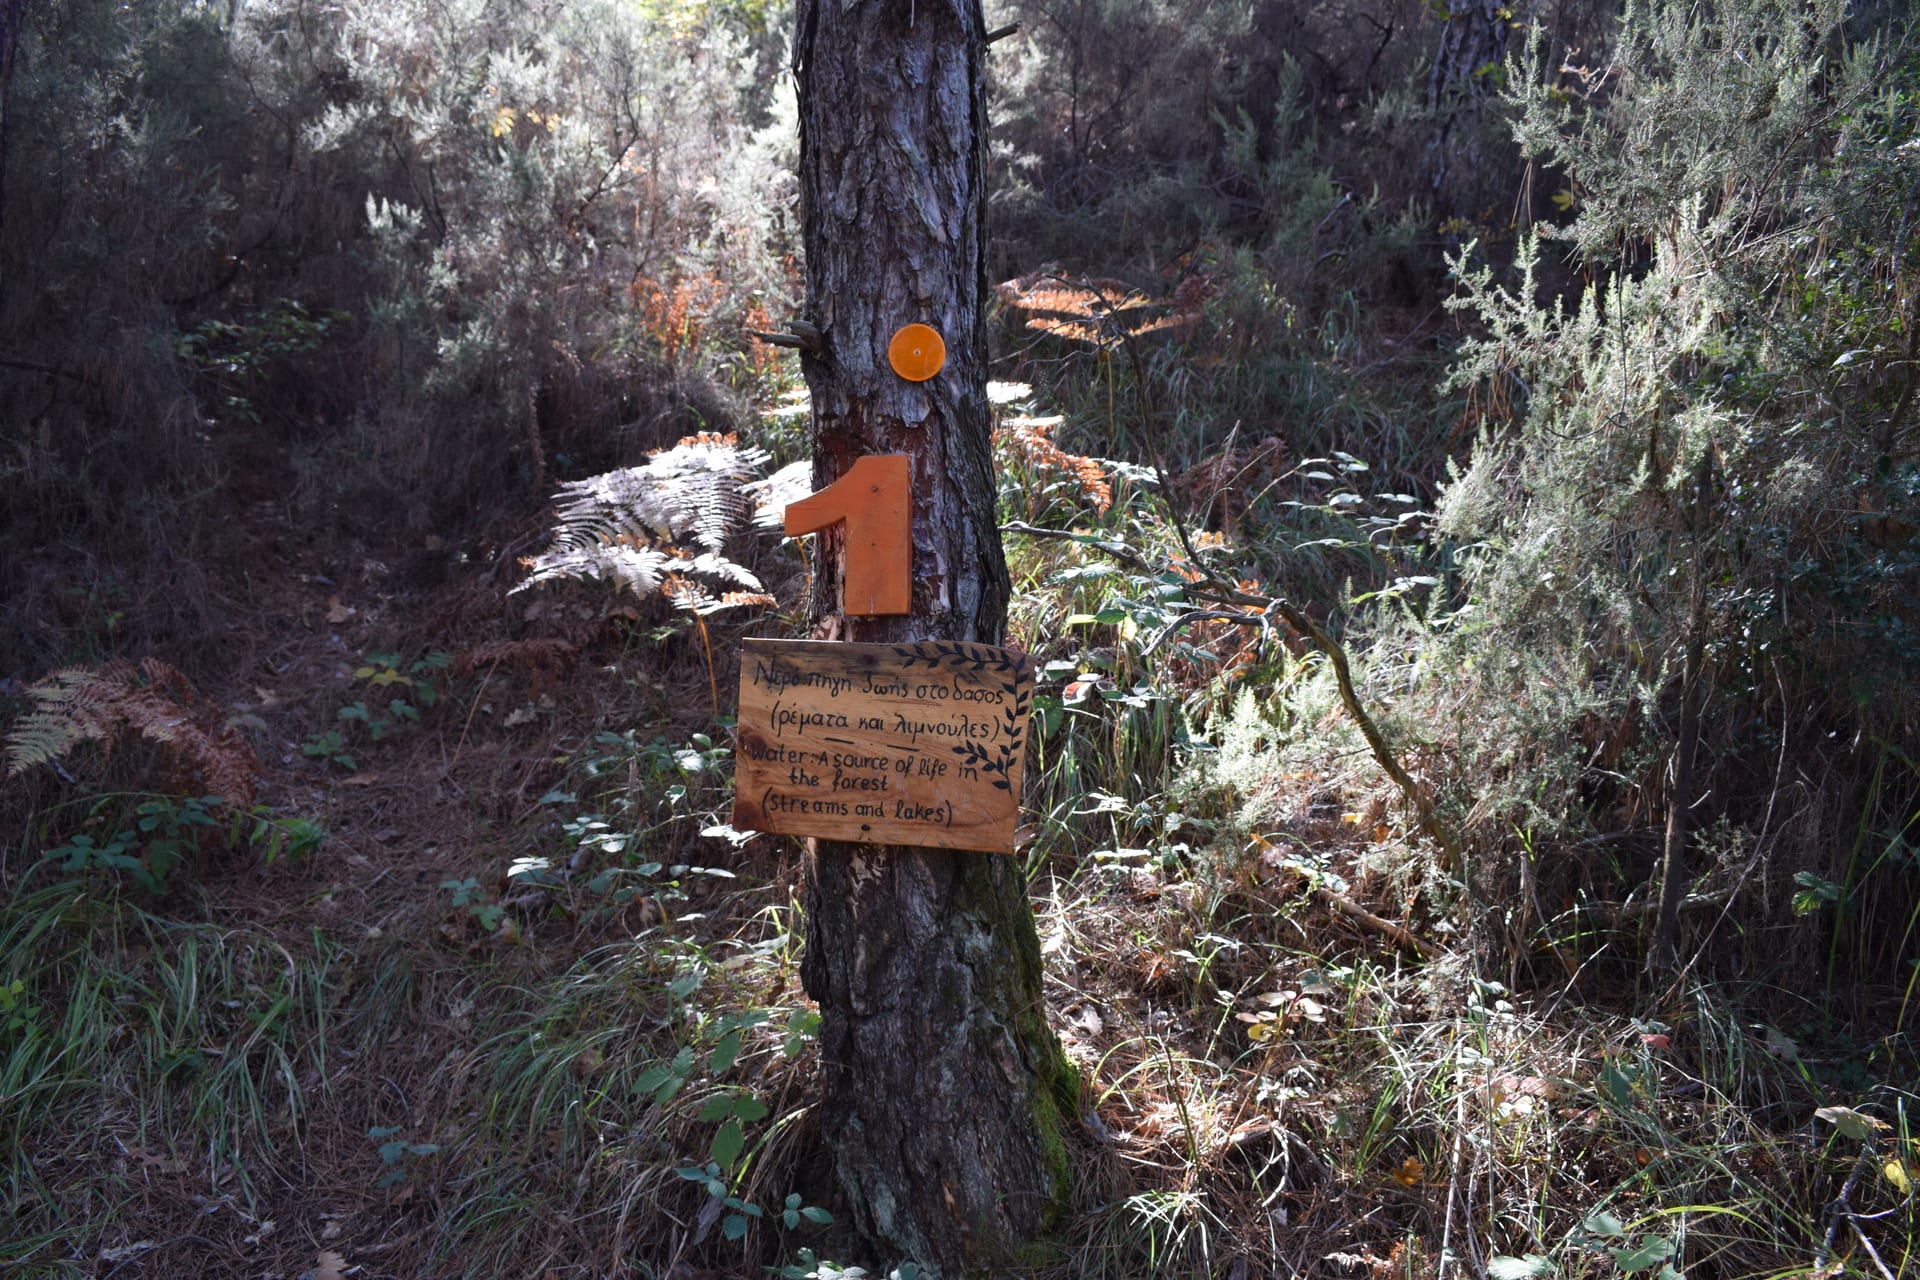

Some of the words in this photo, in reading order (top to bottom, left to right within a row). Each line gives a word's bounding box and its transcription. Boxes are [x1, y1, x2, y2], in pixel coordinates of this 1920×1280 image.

[784, 454, 911, 616] 1
[916, 684, 949, 699] στο
[770, 700, 849, 737] (ρέματα
[858, 716, 885, 731] και
[789, 767, 820, 787] the
[832, 768, 889, 792] forest
[818, 751, 829, 767] A
[832, 753, 889, 771] source
[895, 755, 915, 779] of
[918, 758, 948, 781] life
[958, 761, 979, 783] in
[855, 802, 886, 818] and
[894, 799, 953, 830] lakes)
